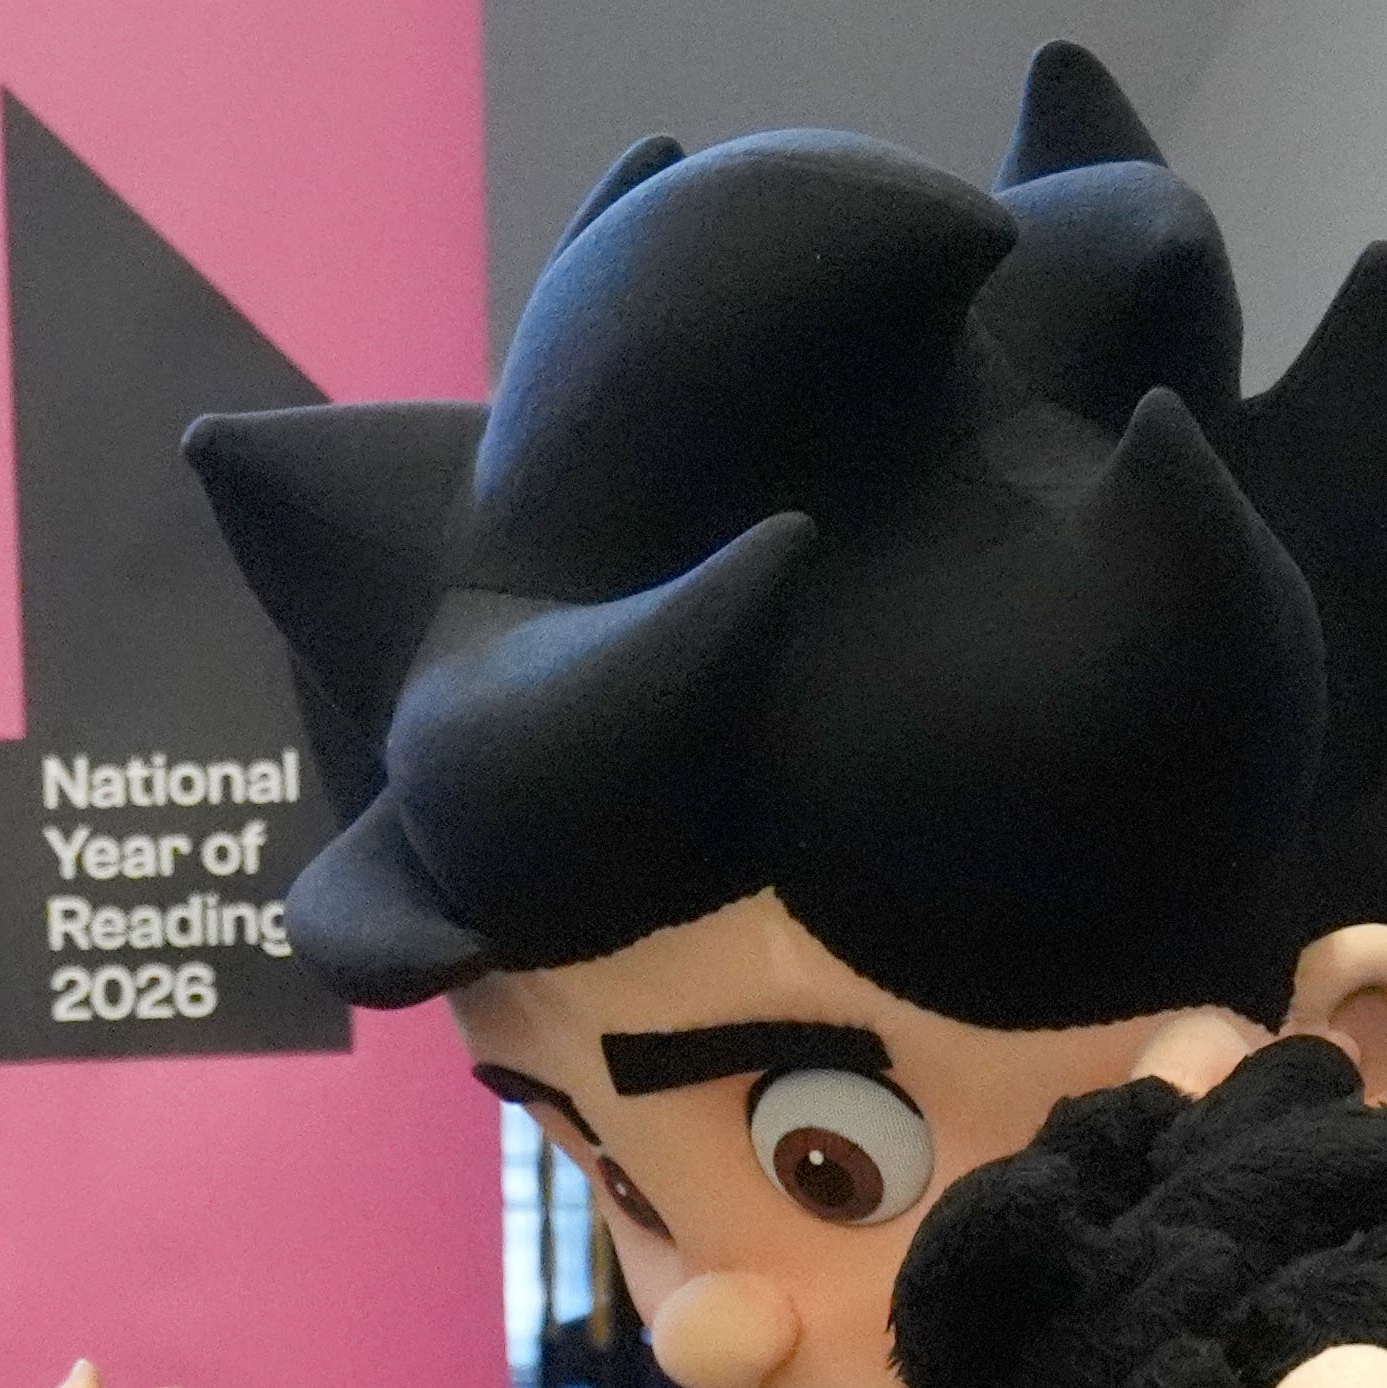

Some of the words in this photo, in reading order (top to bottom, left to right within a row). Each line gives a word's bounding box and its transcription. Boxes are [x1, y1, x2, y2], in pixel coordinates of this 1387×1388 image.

[42, 748, 300, 809] National
[42, 824, 193, 880] Year
[201, 820, 267, 877] of
[47, 893, 293, 957] Reading
[50, 961, 218, 1021] 2026
